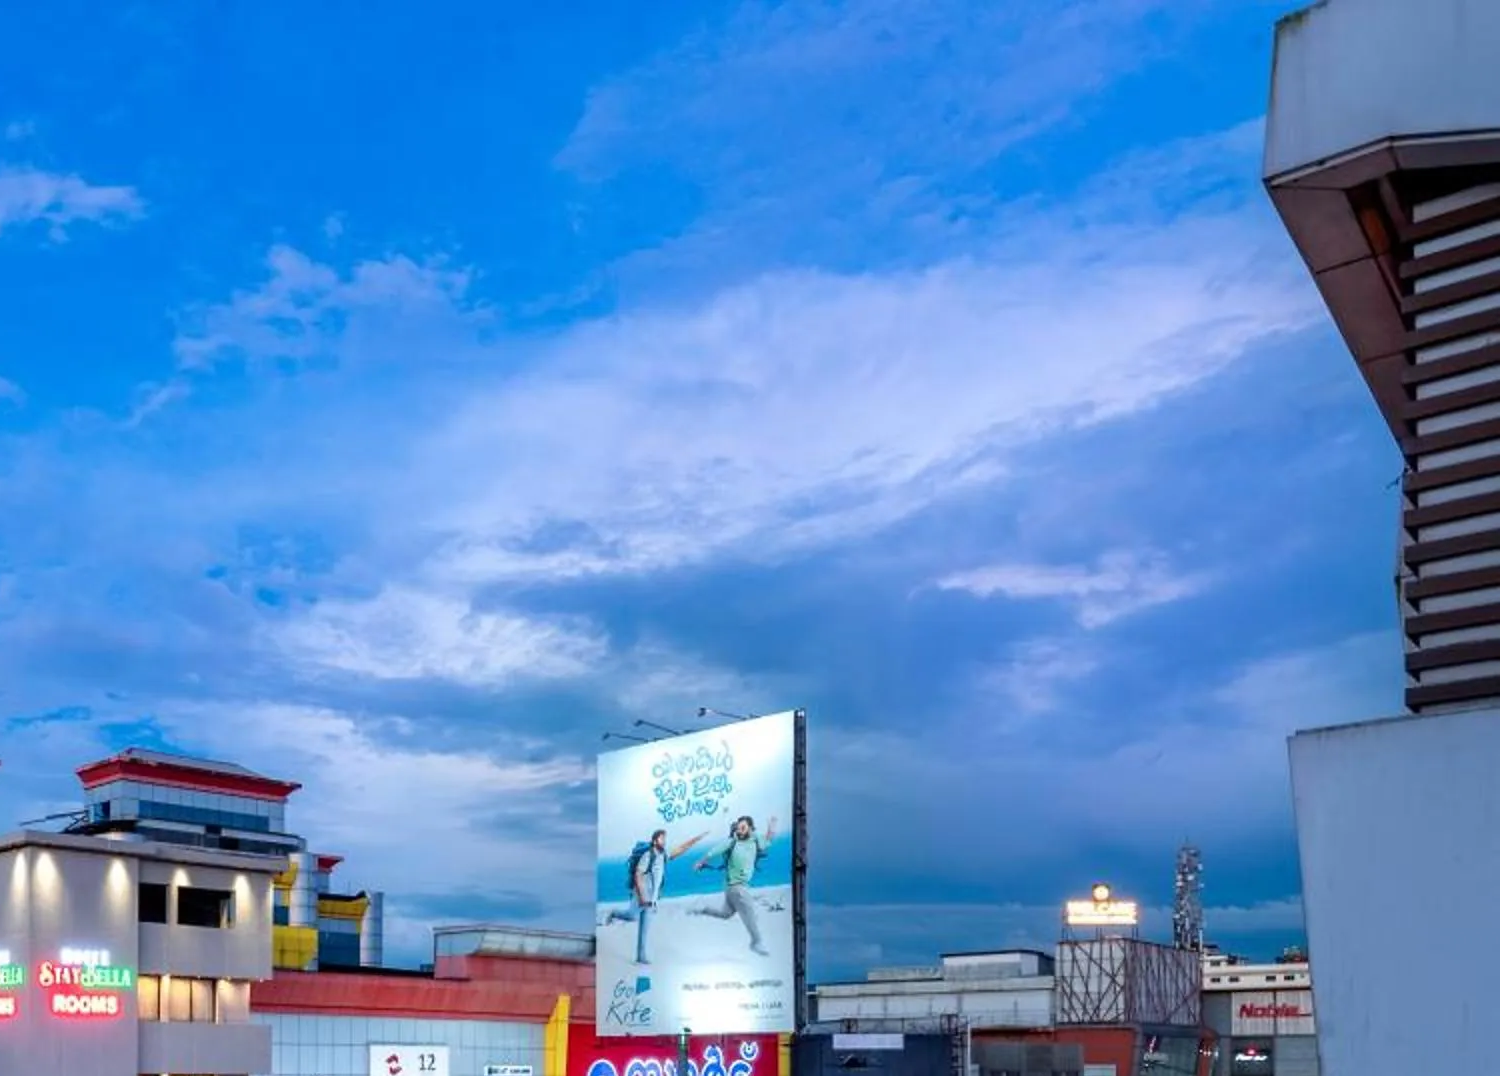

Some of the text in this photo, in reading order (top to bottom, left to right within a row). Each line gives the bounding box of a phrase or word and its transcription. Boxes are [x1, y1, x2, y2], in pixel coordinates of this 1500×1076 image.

[53, 993, 120, 1015] ROOMS
[605, 1001, 651, 1026] Kite
[419, 1053, 437, 1072] 12
